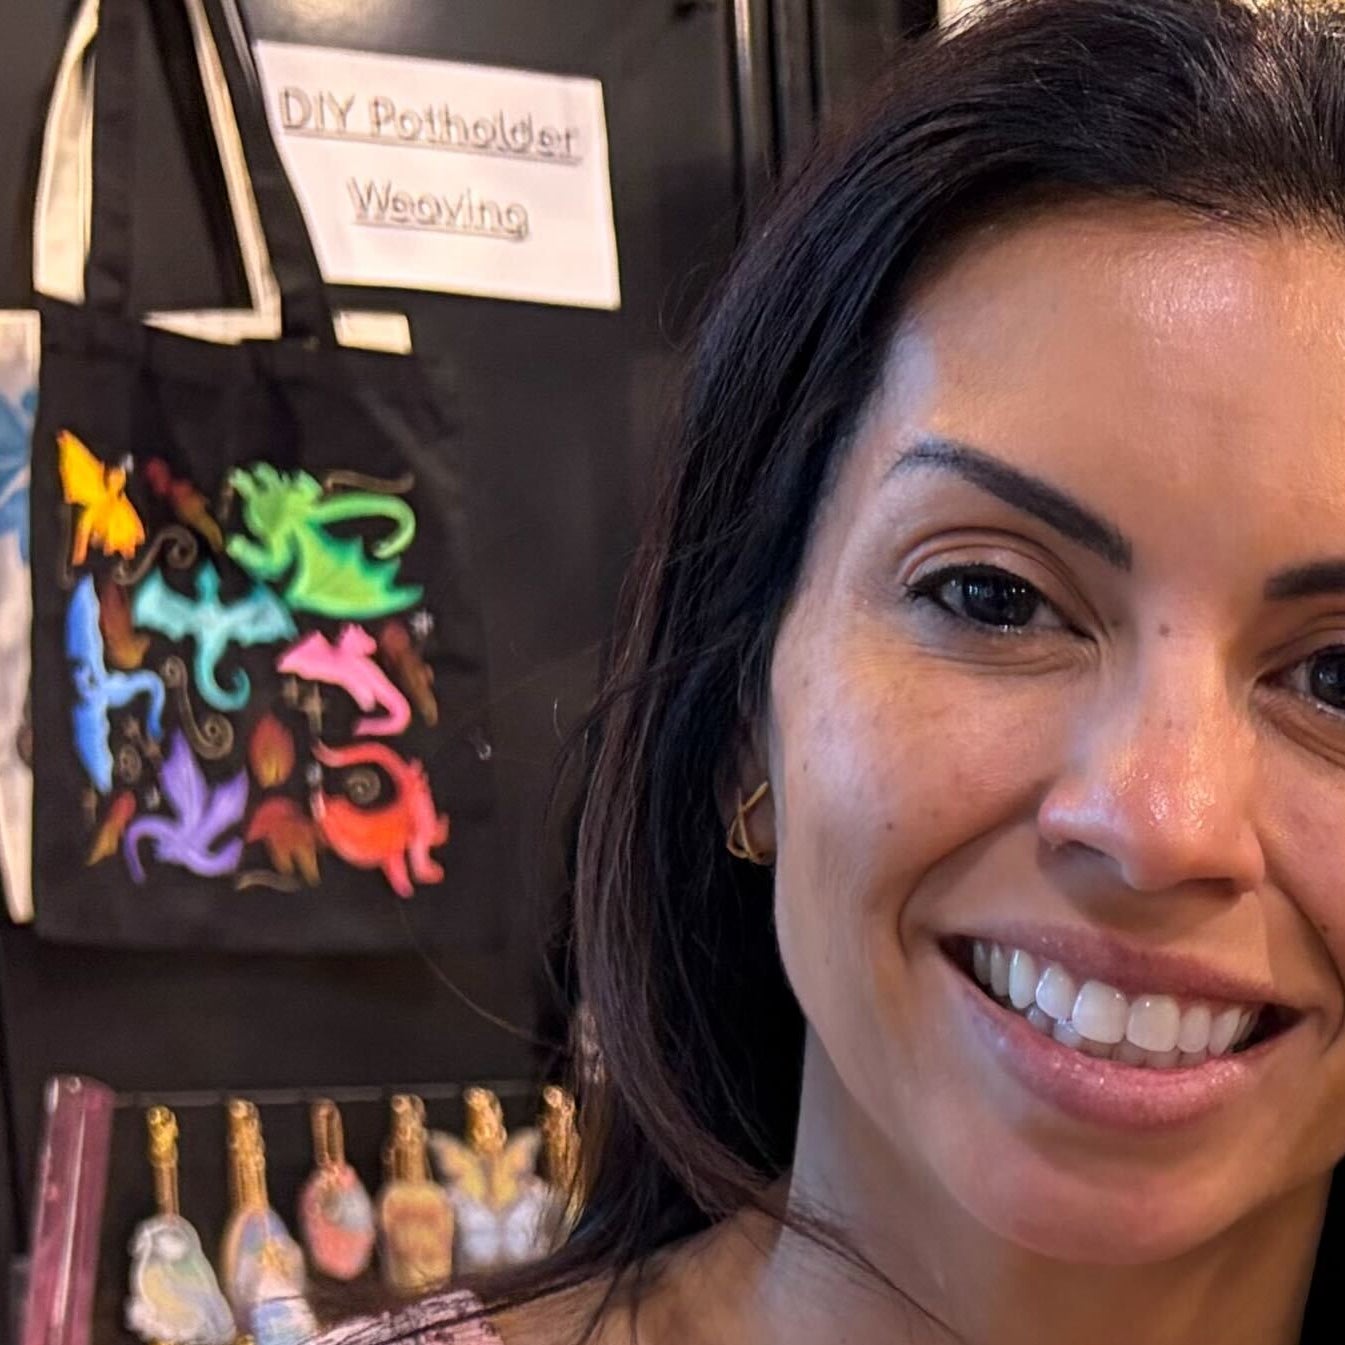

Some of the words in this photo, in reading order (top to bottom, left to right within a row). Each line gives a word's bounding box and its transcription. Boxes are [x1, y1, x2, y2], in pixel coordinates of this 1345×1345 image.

[279, 86, 355, 131] DIY
[368, 95, 579, 157] Potholder
[347, 176, 529, 241] Weaving
